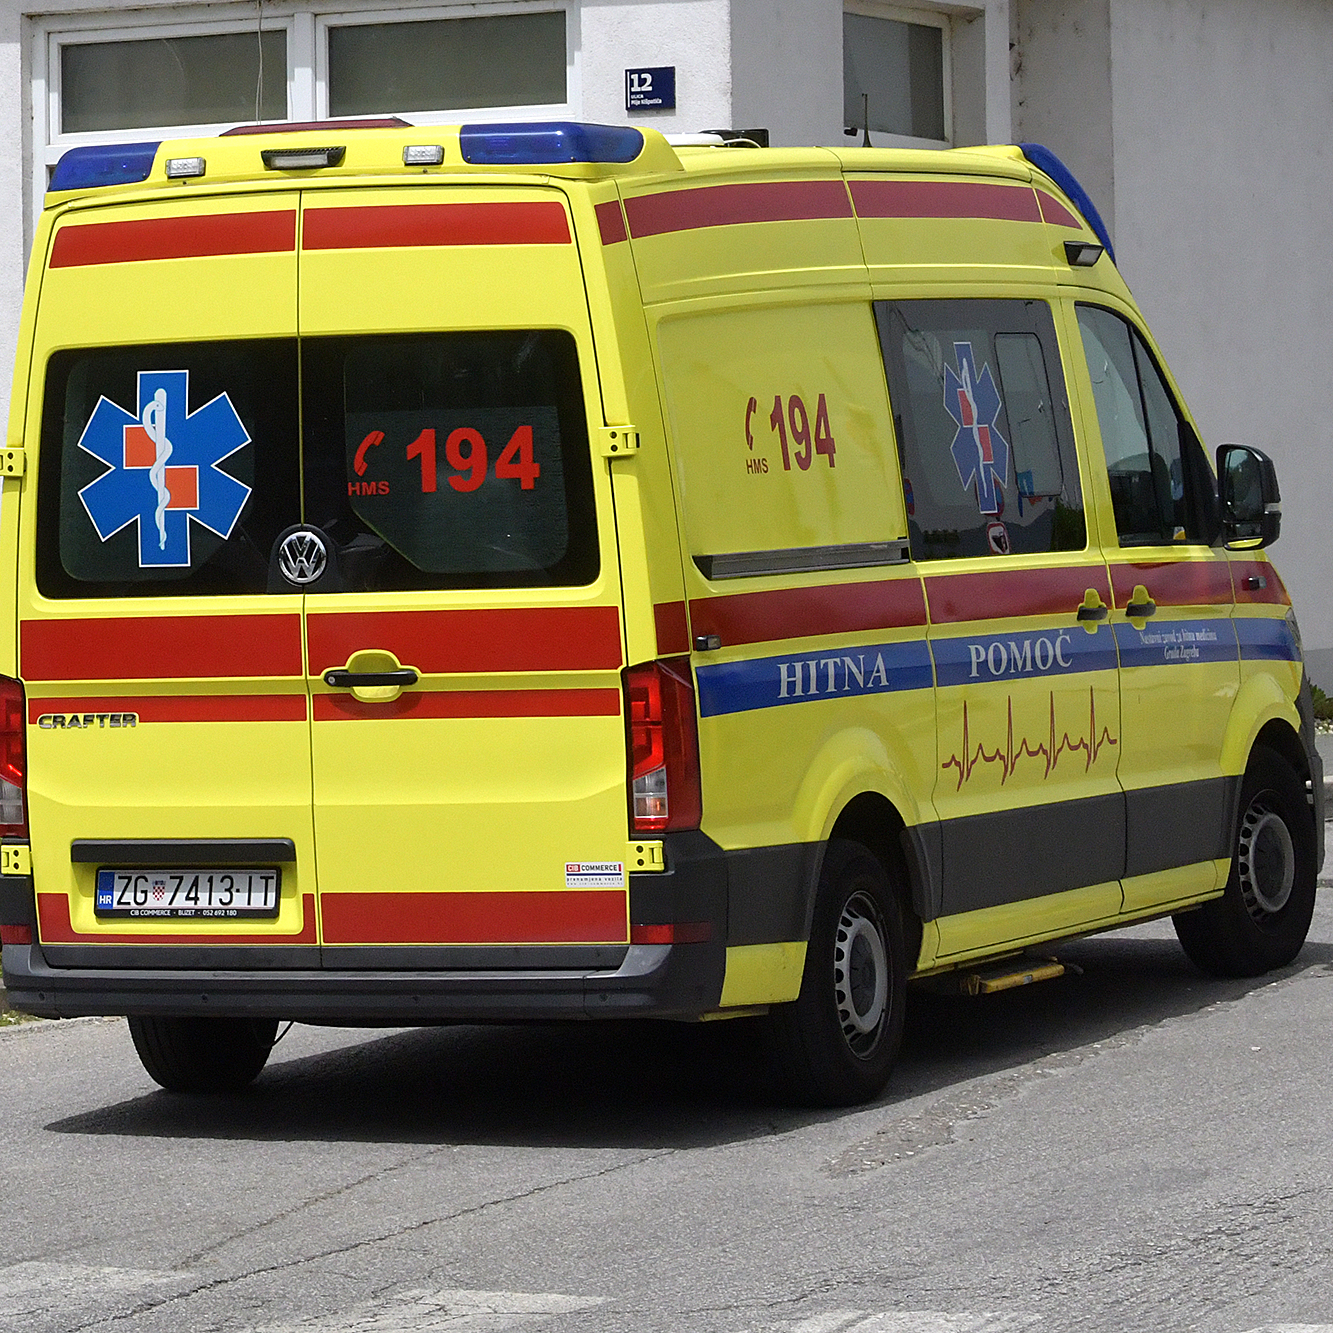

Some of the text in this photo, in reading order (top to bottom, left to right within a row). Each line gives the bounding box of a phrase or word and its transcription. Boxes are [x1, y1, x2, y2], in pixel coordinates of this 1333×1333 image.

[630, 73, 653, 92] 12
[769, 393, 836, 471] 194
[348, 425, 540, 496] HMS 194
[746, 457, 769, 474] HMS
[777, 630, 1073, 699] HITNA POMOĆ
[38, 713, 136, 729] CRAFTER
[99, 894, 112, 905] HR
[116, 875, 149, 906] ZG
[140, 909, 171, 917] COMMERCE
[202, 909, 214, 917] 052
